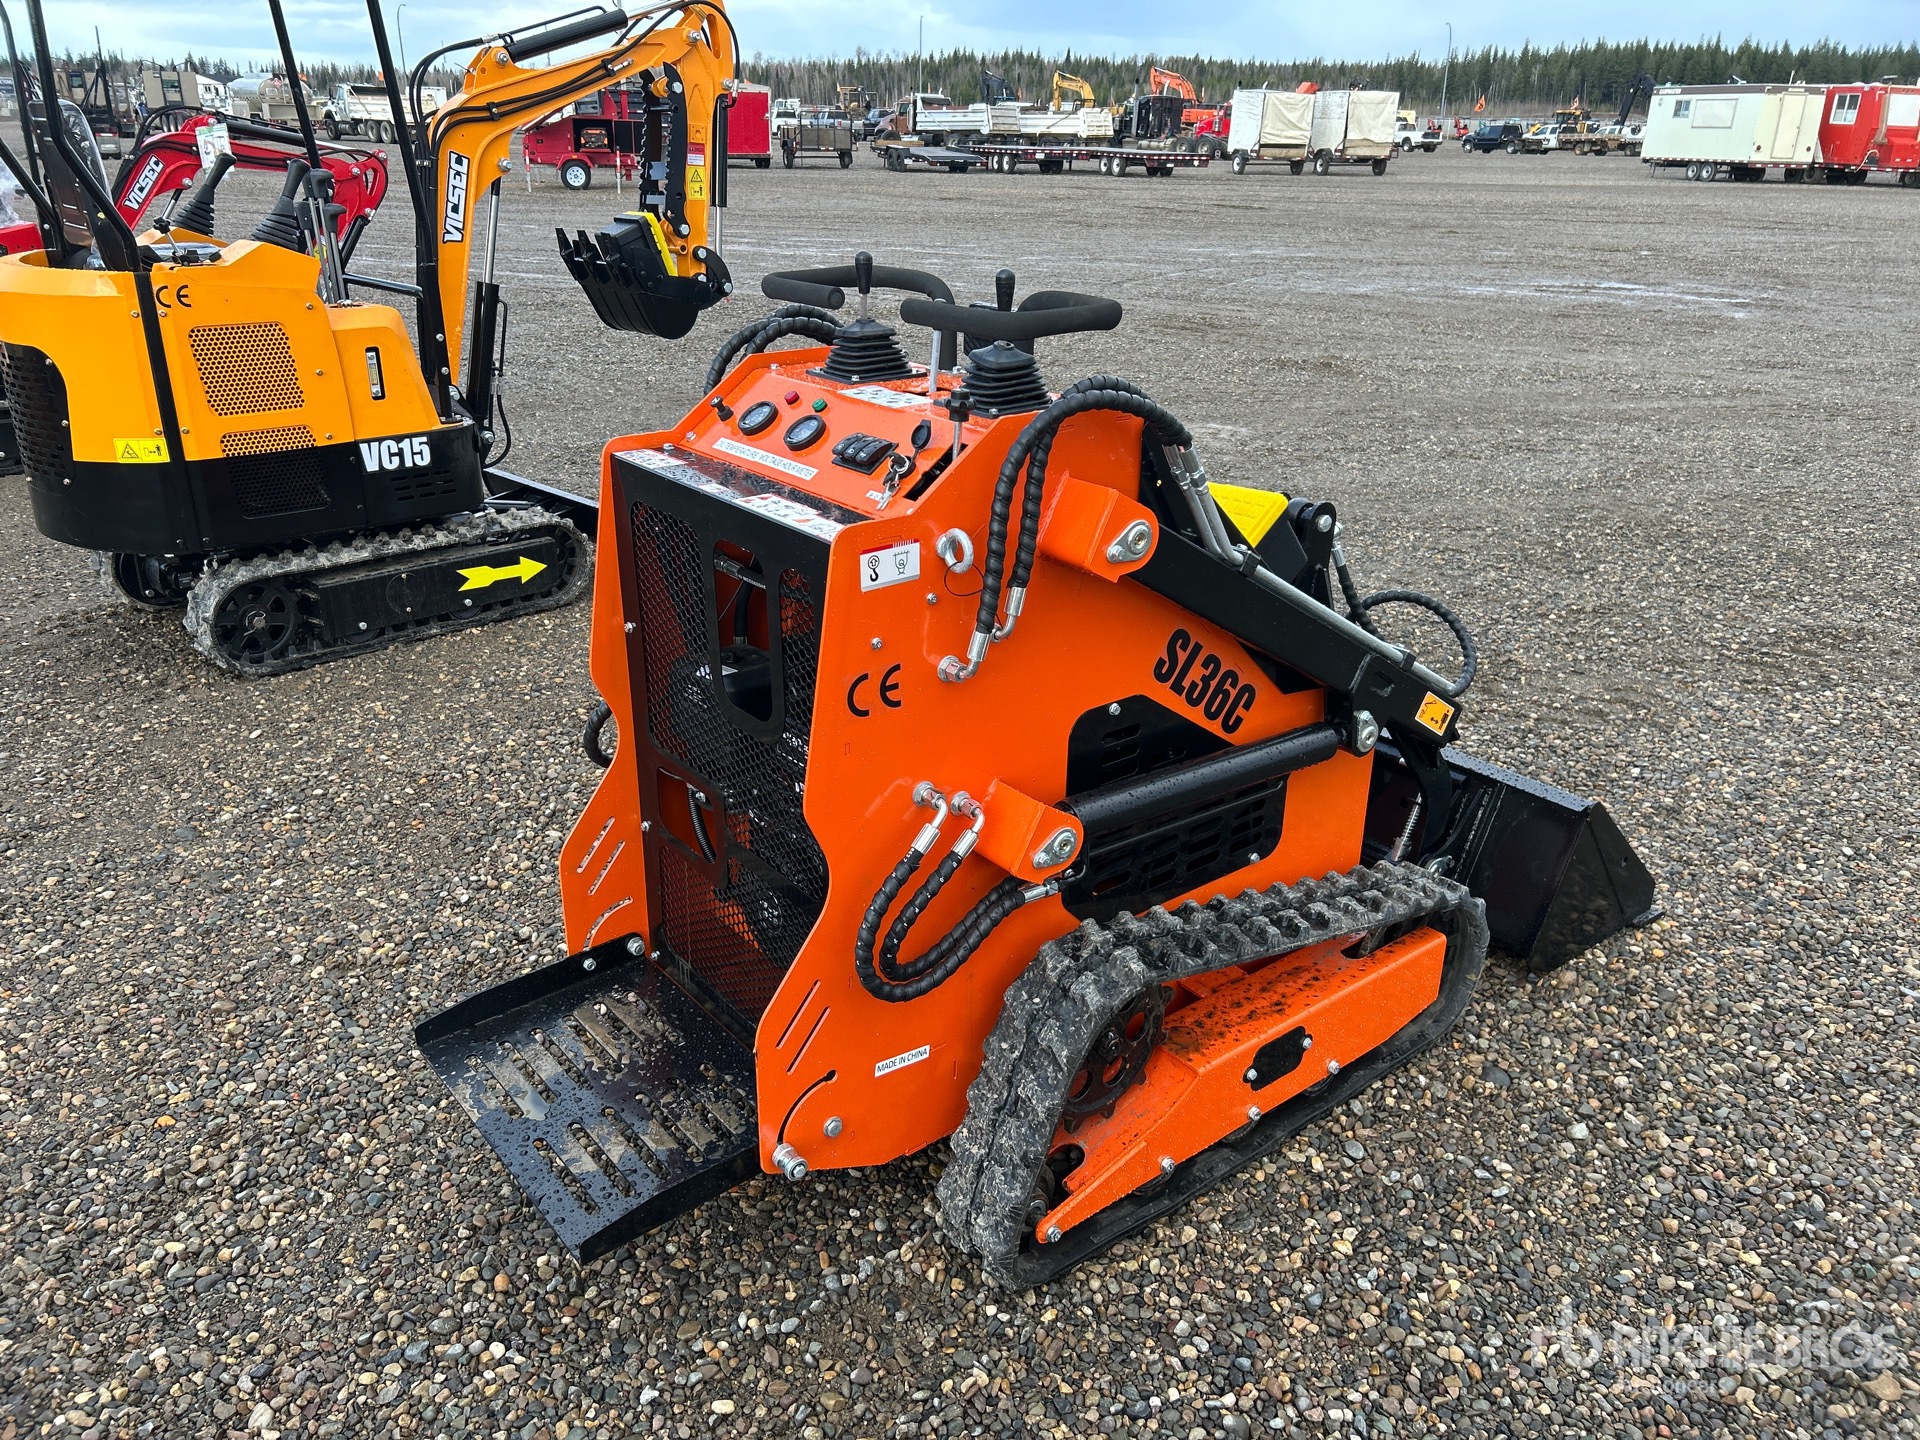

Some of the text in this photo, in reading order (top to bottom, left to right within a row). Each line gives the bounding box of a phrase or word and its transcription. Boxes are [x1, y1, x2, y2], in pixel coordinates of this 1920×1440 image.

[123, 155, 164, 210] VICSEC
[443, 151, 469, 243] VICSEC
[359, 437, 431, 472] VC15
[847, 663, 902, 718] CE
[1153, 628, 1256, 734] SL36C
[876, 1047, 928, 1073] MADE IN CHINA
